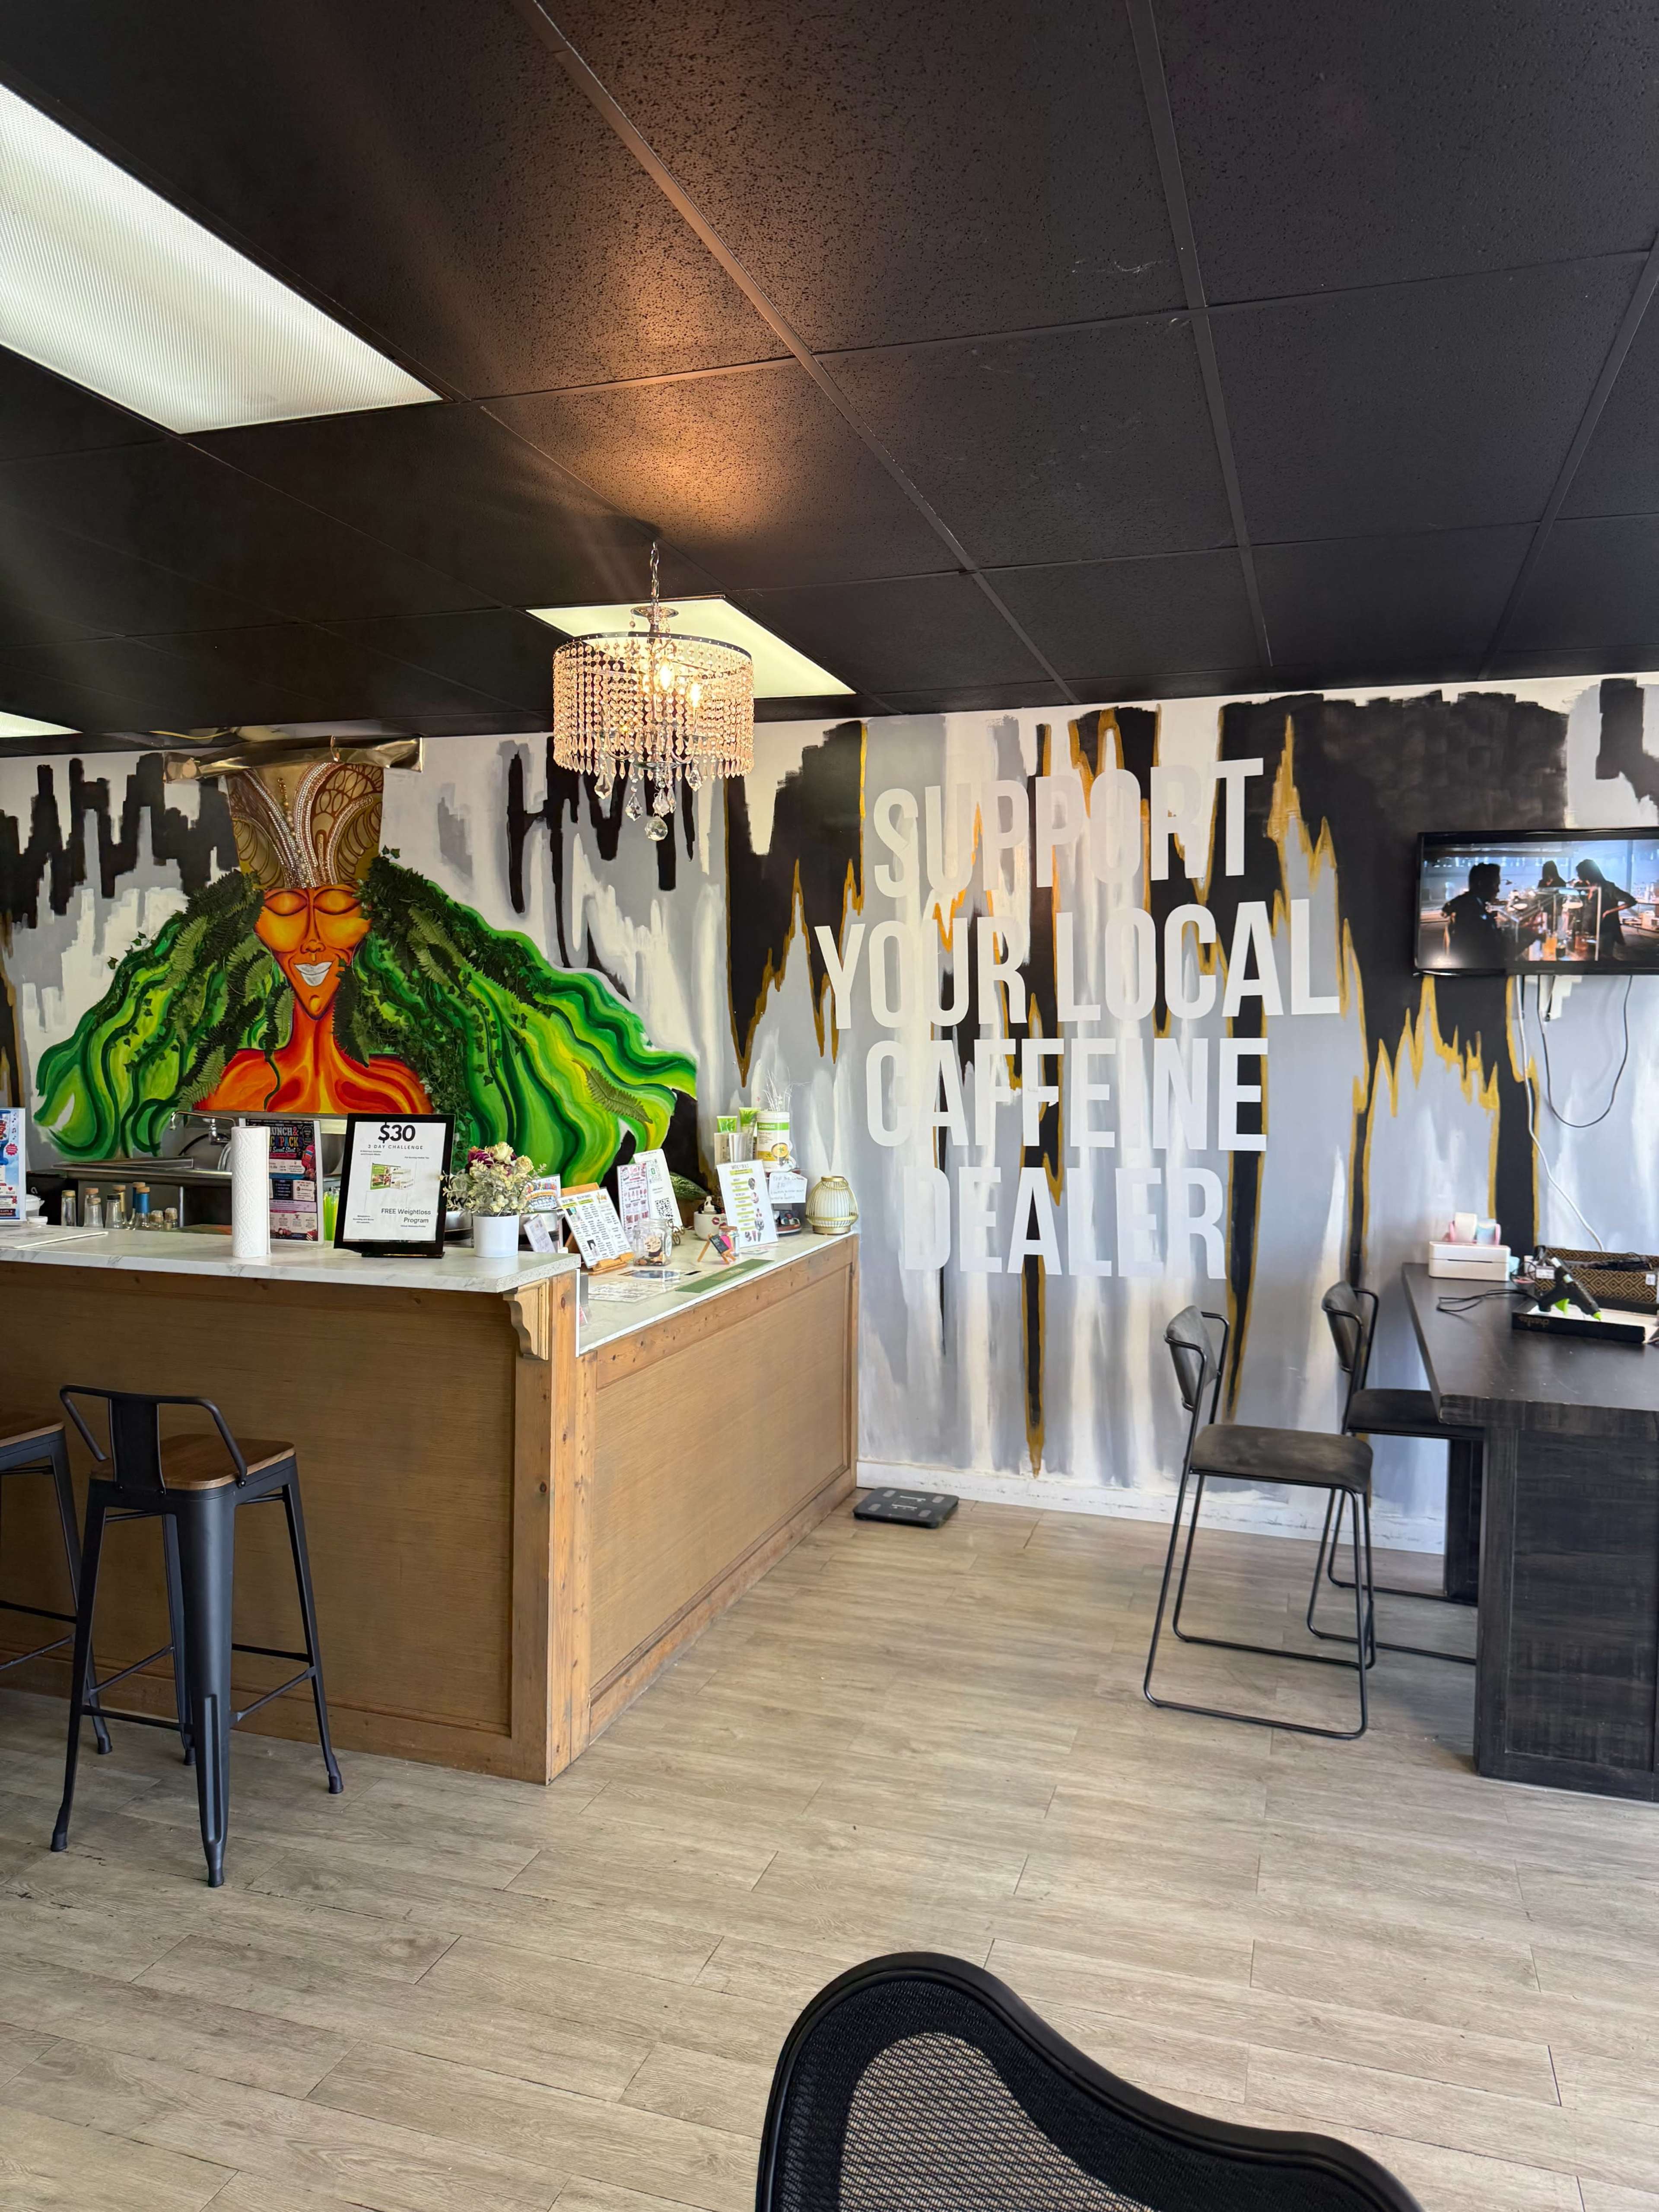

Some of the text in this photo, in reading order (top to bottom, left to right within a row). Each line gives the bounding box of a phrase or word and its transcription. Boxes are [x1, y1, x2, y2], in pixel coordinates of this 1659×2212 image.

[874, 758, 1263, 898] SUPPORT
[814, 899, 1340, 1029] YOUR LOCAL
[378, 1122, 416, 1143] $30
[865, 1038, 1268, 1152] CAFFEINE
[903, 1166, 1227, 1279] DEALER
